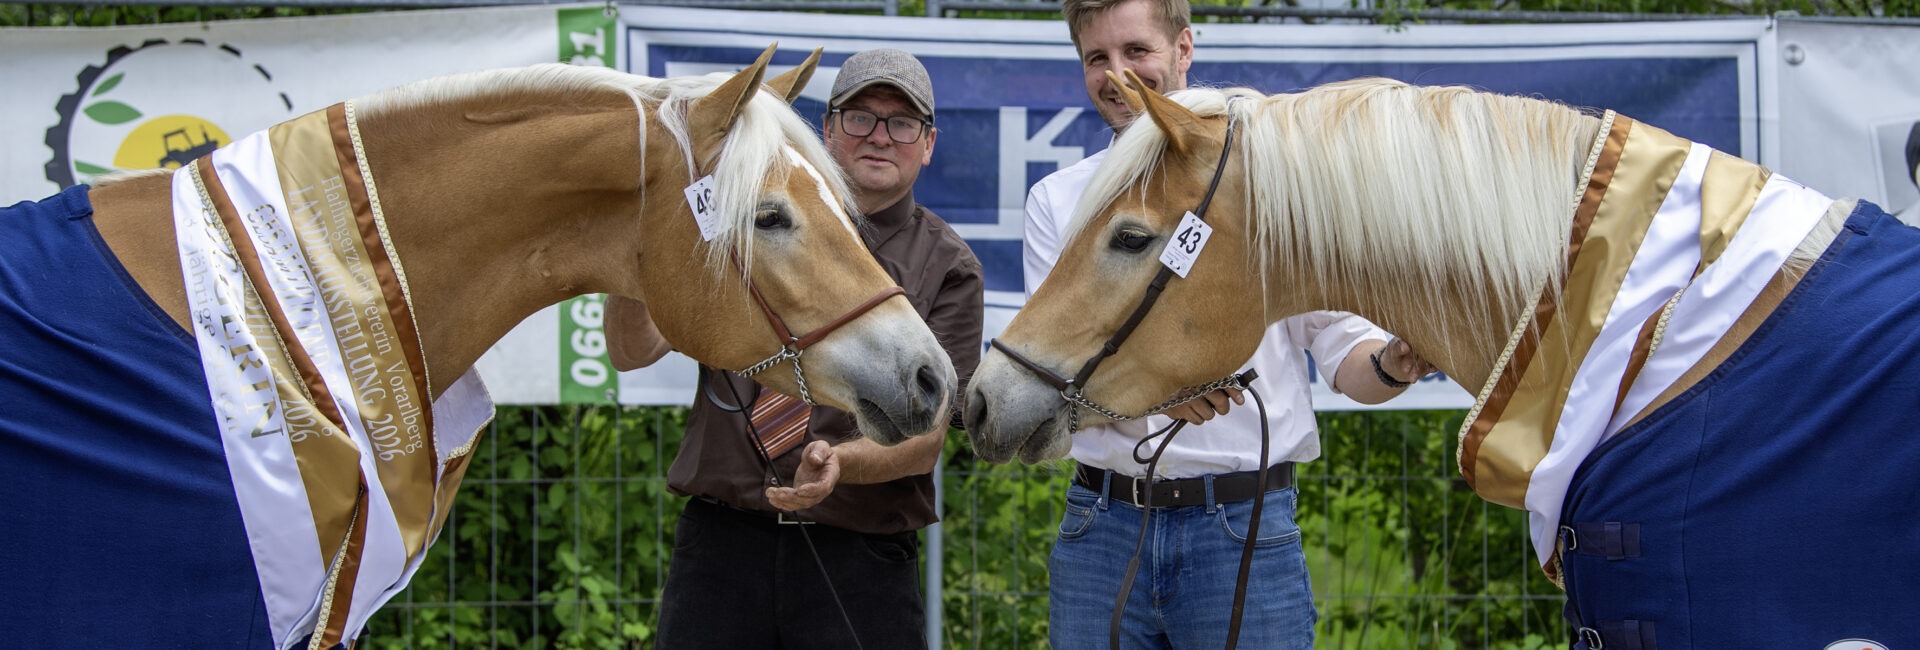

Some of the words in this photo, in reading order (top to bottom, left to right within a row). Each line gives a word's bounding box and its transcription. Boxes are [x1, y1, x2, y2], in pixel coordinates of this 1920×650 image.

[1177, 226, 1201, 254] 43
[184, 248, 216, 336] jährige
[288, 185, 384, 406] LANDESAUSSTELLUNG
[368, 414, 404, 462] 2026
[571, 293, 608, 387] 066
[283, 398, 317, 443] 2026
[385, 359, 424, 452] Vorarlberg
